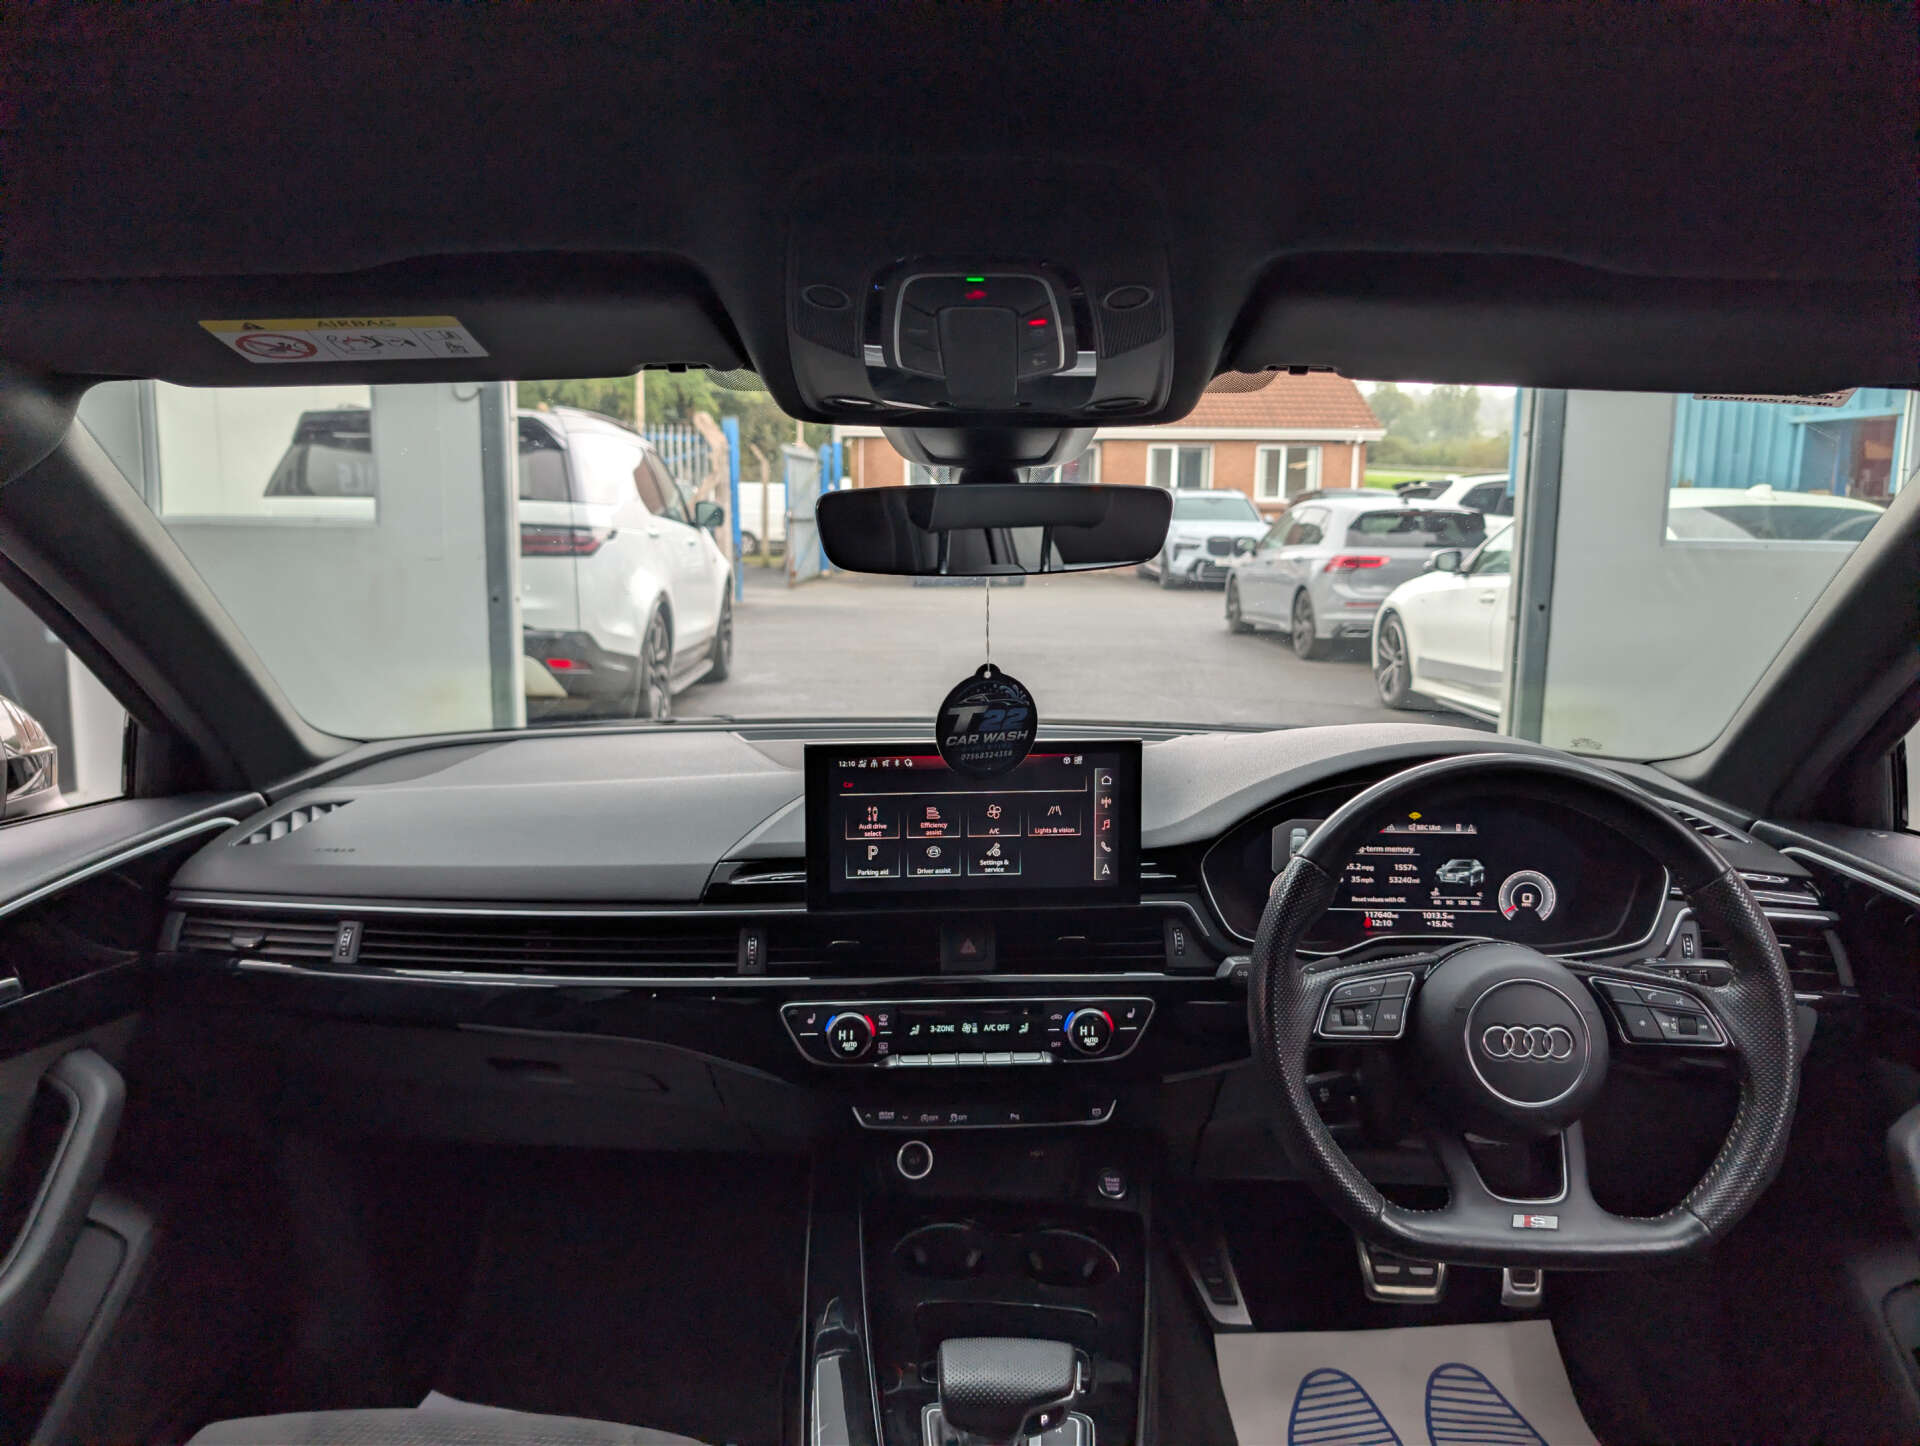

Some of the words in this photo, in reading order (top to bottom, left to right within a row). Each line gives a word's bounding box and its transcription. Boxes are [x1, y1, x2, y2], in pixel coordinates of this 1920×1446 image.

[317, 319, 396, 328] AIRBAG
[946, 705, 1029, 733] T22
[945, 734, 980, 747] CAR
[983, 730, 1029, 743] WASH
[920, 822, 948, 830] Efficiency
[1034, 827, 1052, 835] Lights
[979, 859, 1003, 867] Settings
[857, 869, 879, 877] Parking
[1371, 919, 1393, 927] 12:10
[929, 1024, 955, 1033] 3-ZONE
[997, 1023, 1011, 1031] OFF
[1040, 1414, 1048, 1426] P
